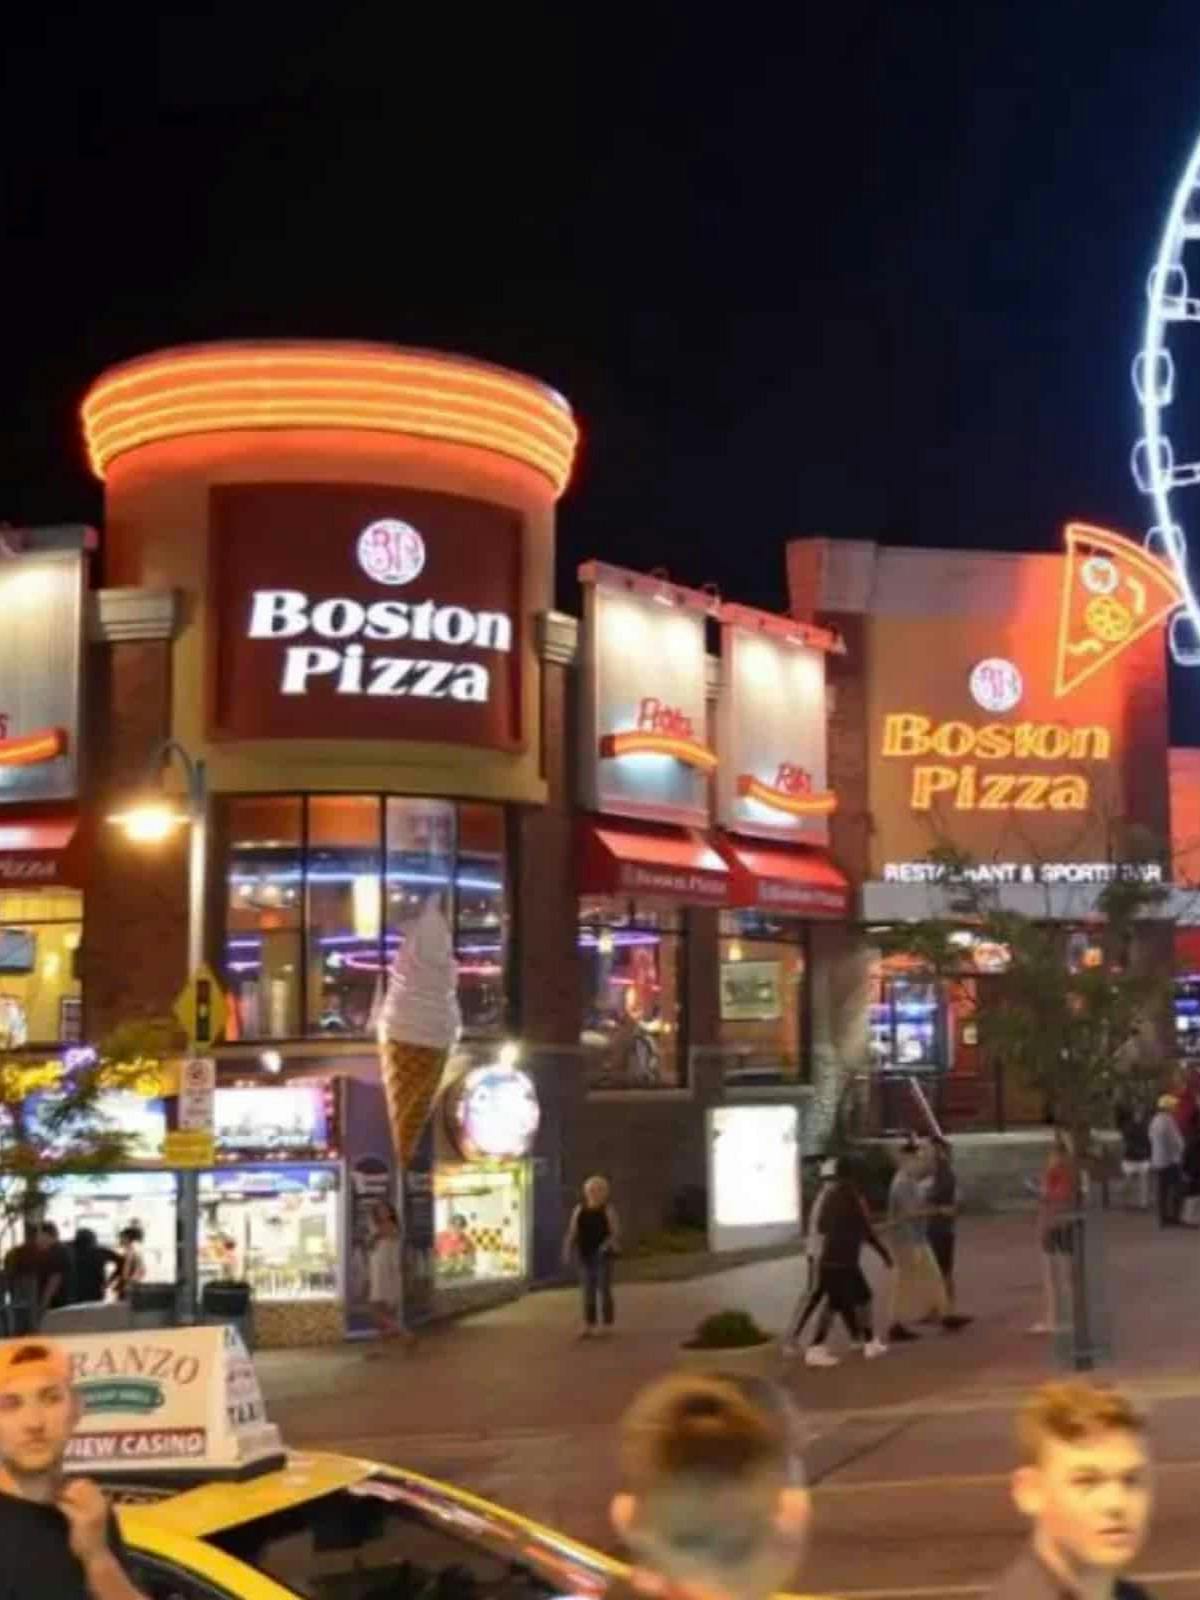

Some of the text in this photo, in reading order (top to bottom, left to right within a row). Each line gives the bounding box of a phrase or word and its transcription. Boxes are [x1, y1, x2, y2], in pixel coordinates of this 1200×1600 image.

[248, 589, 511, 653] Boston
[280, 644, 489, 703] Pizza
[880, 712, 1112, 762] Boston
[910, 765, 1090, 811] Pizza
[884, 863, 1018, 883] RESTARANT
[120, 1432, 203, 1456] CASINO
